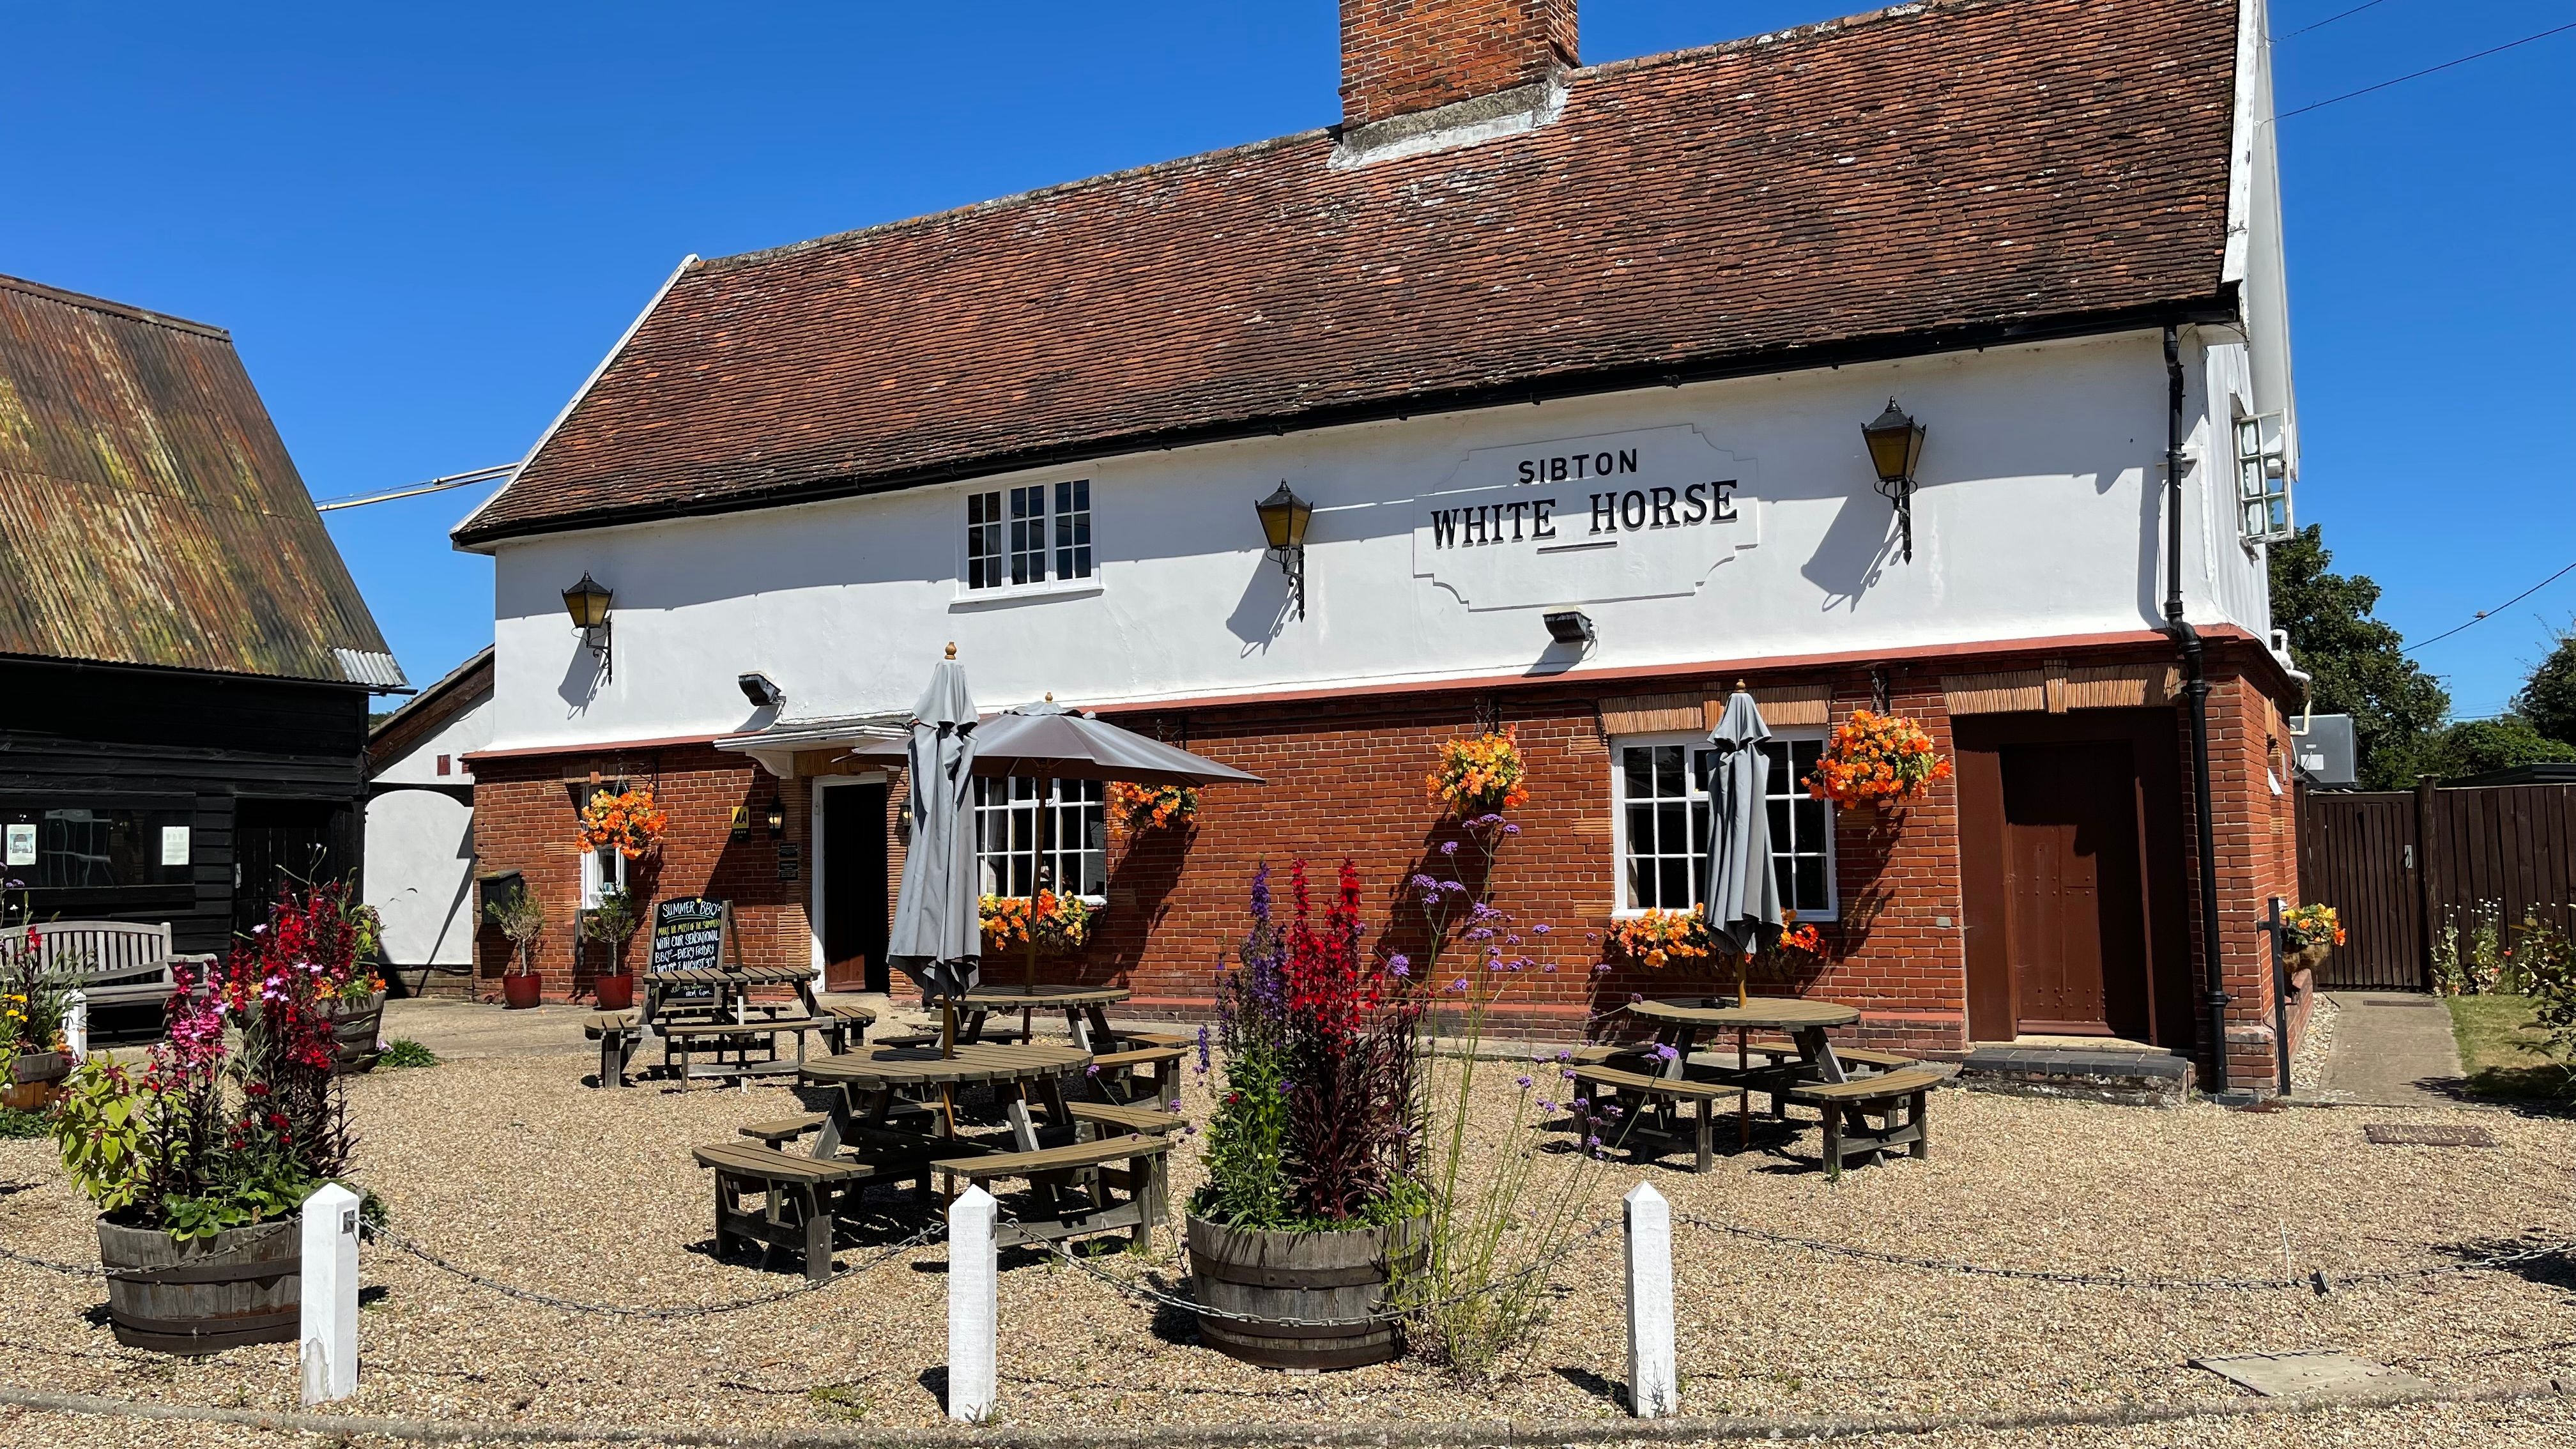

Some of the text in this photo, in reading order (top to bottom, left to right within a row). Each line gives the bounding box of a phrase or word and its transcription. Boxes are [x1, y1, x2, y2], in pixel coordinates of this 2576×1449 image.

[1518, 448, 1638, 484] SIBTON
[1430, 479, 1738, 549] WHITE HORSE
[733, 811, 747, 824] AA
[663, 901, 695, 917] SUMMER
[671, 934, 684, 947] OUR
[685, 930, 720, 946] SENSATIONAL
[682, 958, 705, 972] AUGUST
[699, 988, 714, 997] 6pm
